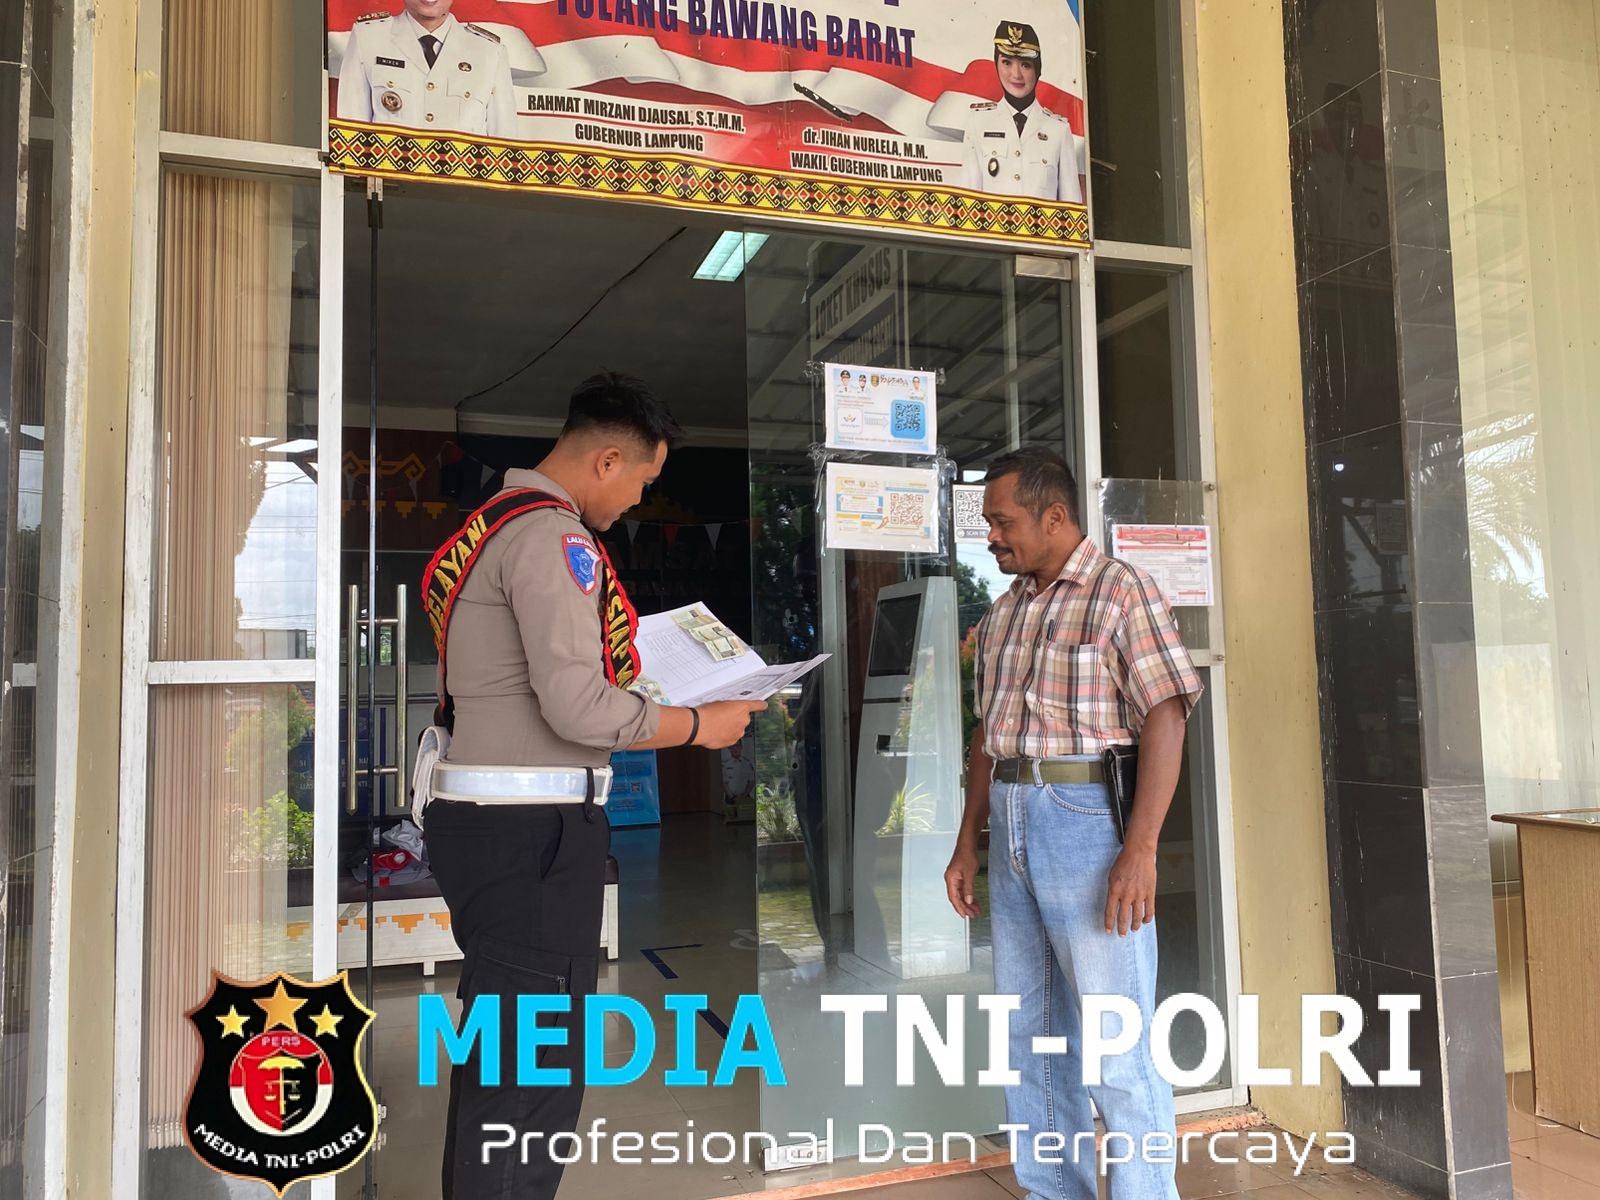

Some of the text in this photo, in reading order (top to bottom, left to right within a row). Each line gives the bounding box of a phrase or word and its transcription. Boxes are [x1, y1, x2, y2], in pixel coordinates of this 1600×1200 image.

[688, 0, 818, 52] BAWANG
[826, 15, 915, 68] BARAT
[527, 94, 581, 113] RAHMAT
[583, 98, 636, 122] MIRZANI
[638, 106, 694, 127] DJAUSAL,
[575, 123, 704, 151] GUBERNUR LAMPUNG
[803, 128, 928, 160] dr. JIHAN NURLELA, M.M.
[791, 151, 943, 182] WAKIL GUBERNUR LAMPUNG
[815, 284, 843, 340] LOKET
[846, 247, 891, 316] KHUSUS
[608, 595, 630, 660] SIAP
